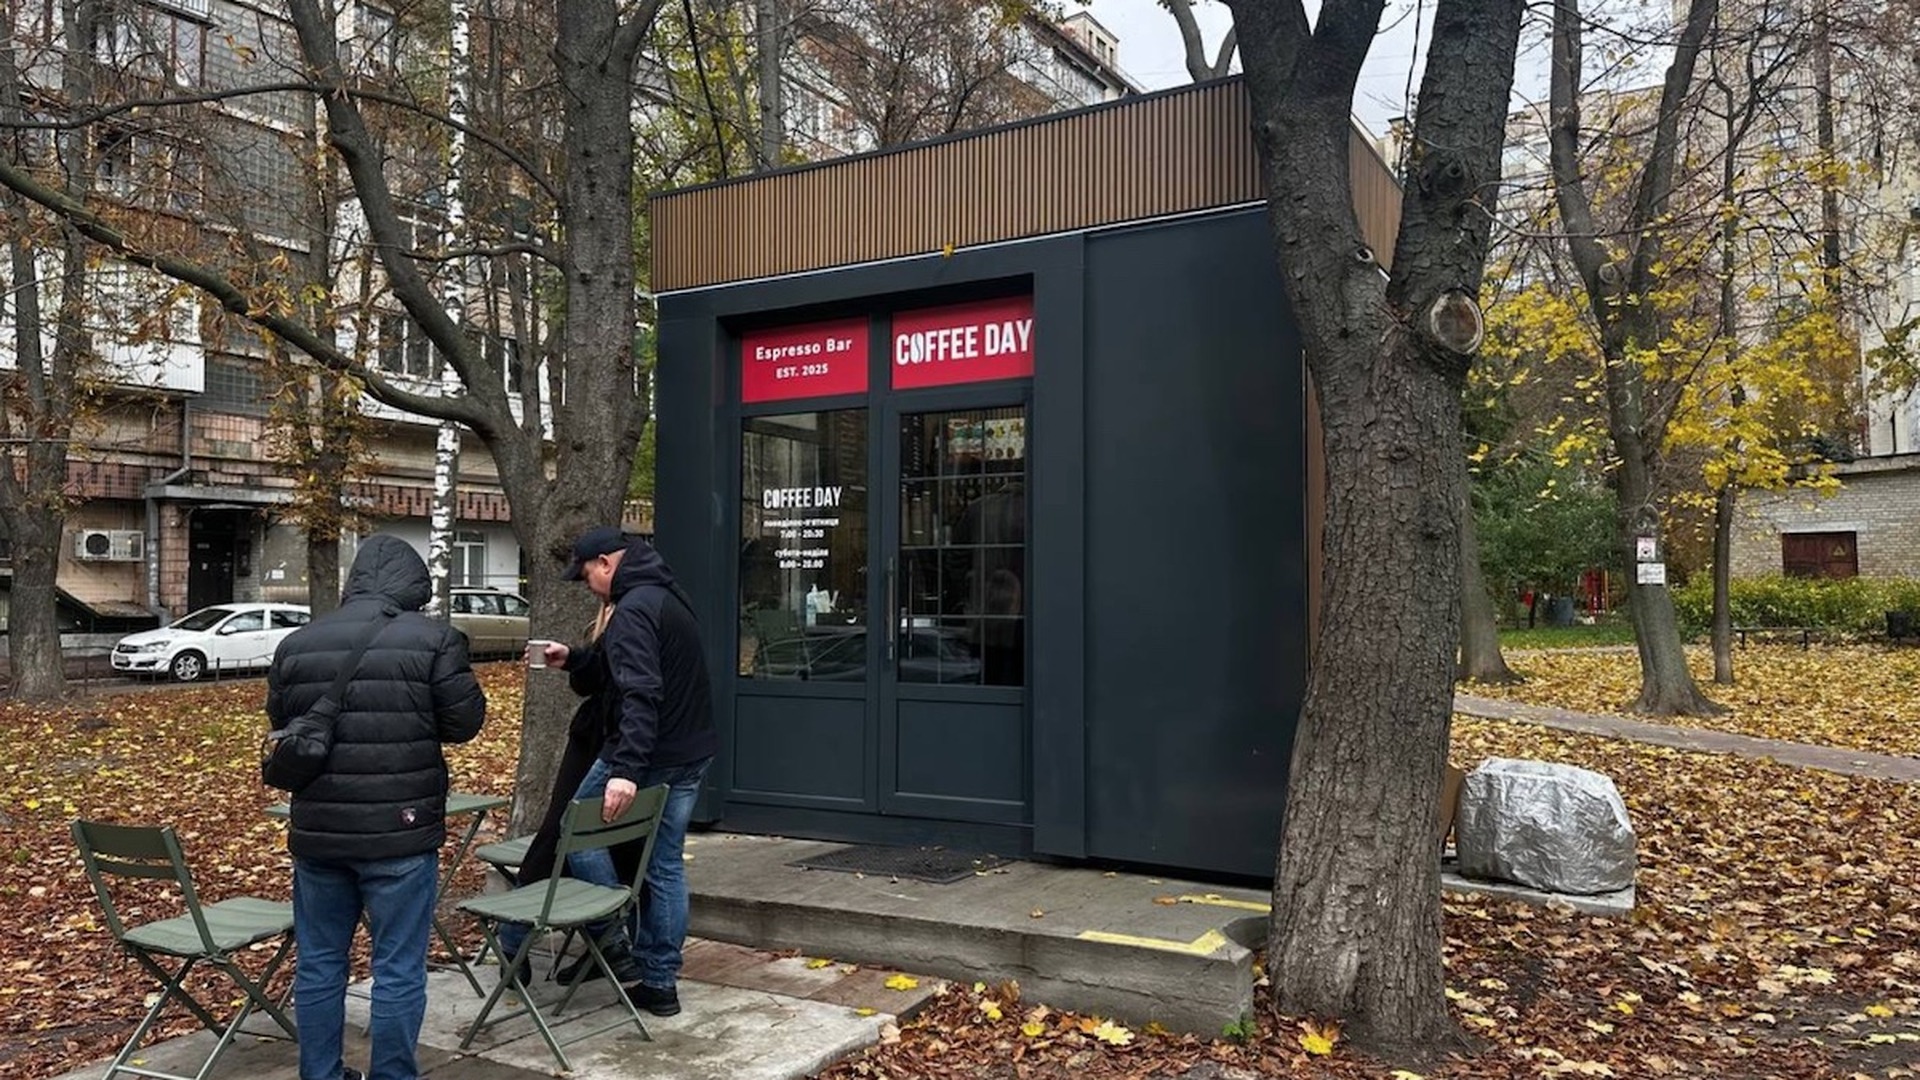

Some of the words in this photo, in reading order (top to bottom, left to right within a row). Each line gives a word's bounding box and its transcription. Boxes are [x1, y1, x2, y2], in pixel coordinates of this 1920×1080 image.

[755, 340, 821, 361] Espresso
[826, 337, 853, 353] Bar
[896, 326, 978, 366] COFFEE
[985, 319, 1032, 356] DAY
[775, 366, 799, 379] EST.
[802, 363, 828, 376] 2025
[763, 488, 812, 508] COFFEE
[815, 486, 842, 507] DAY
